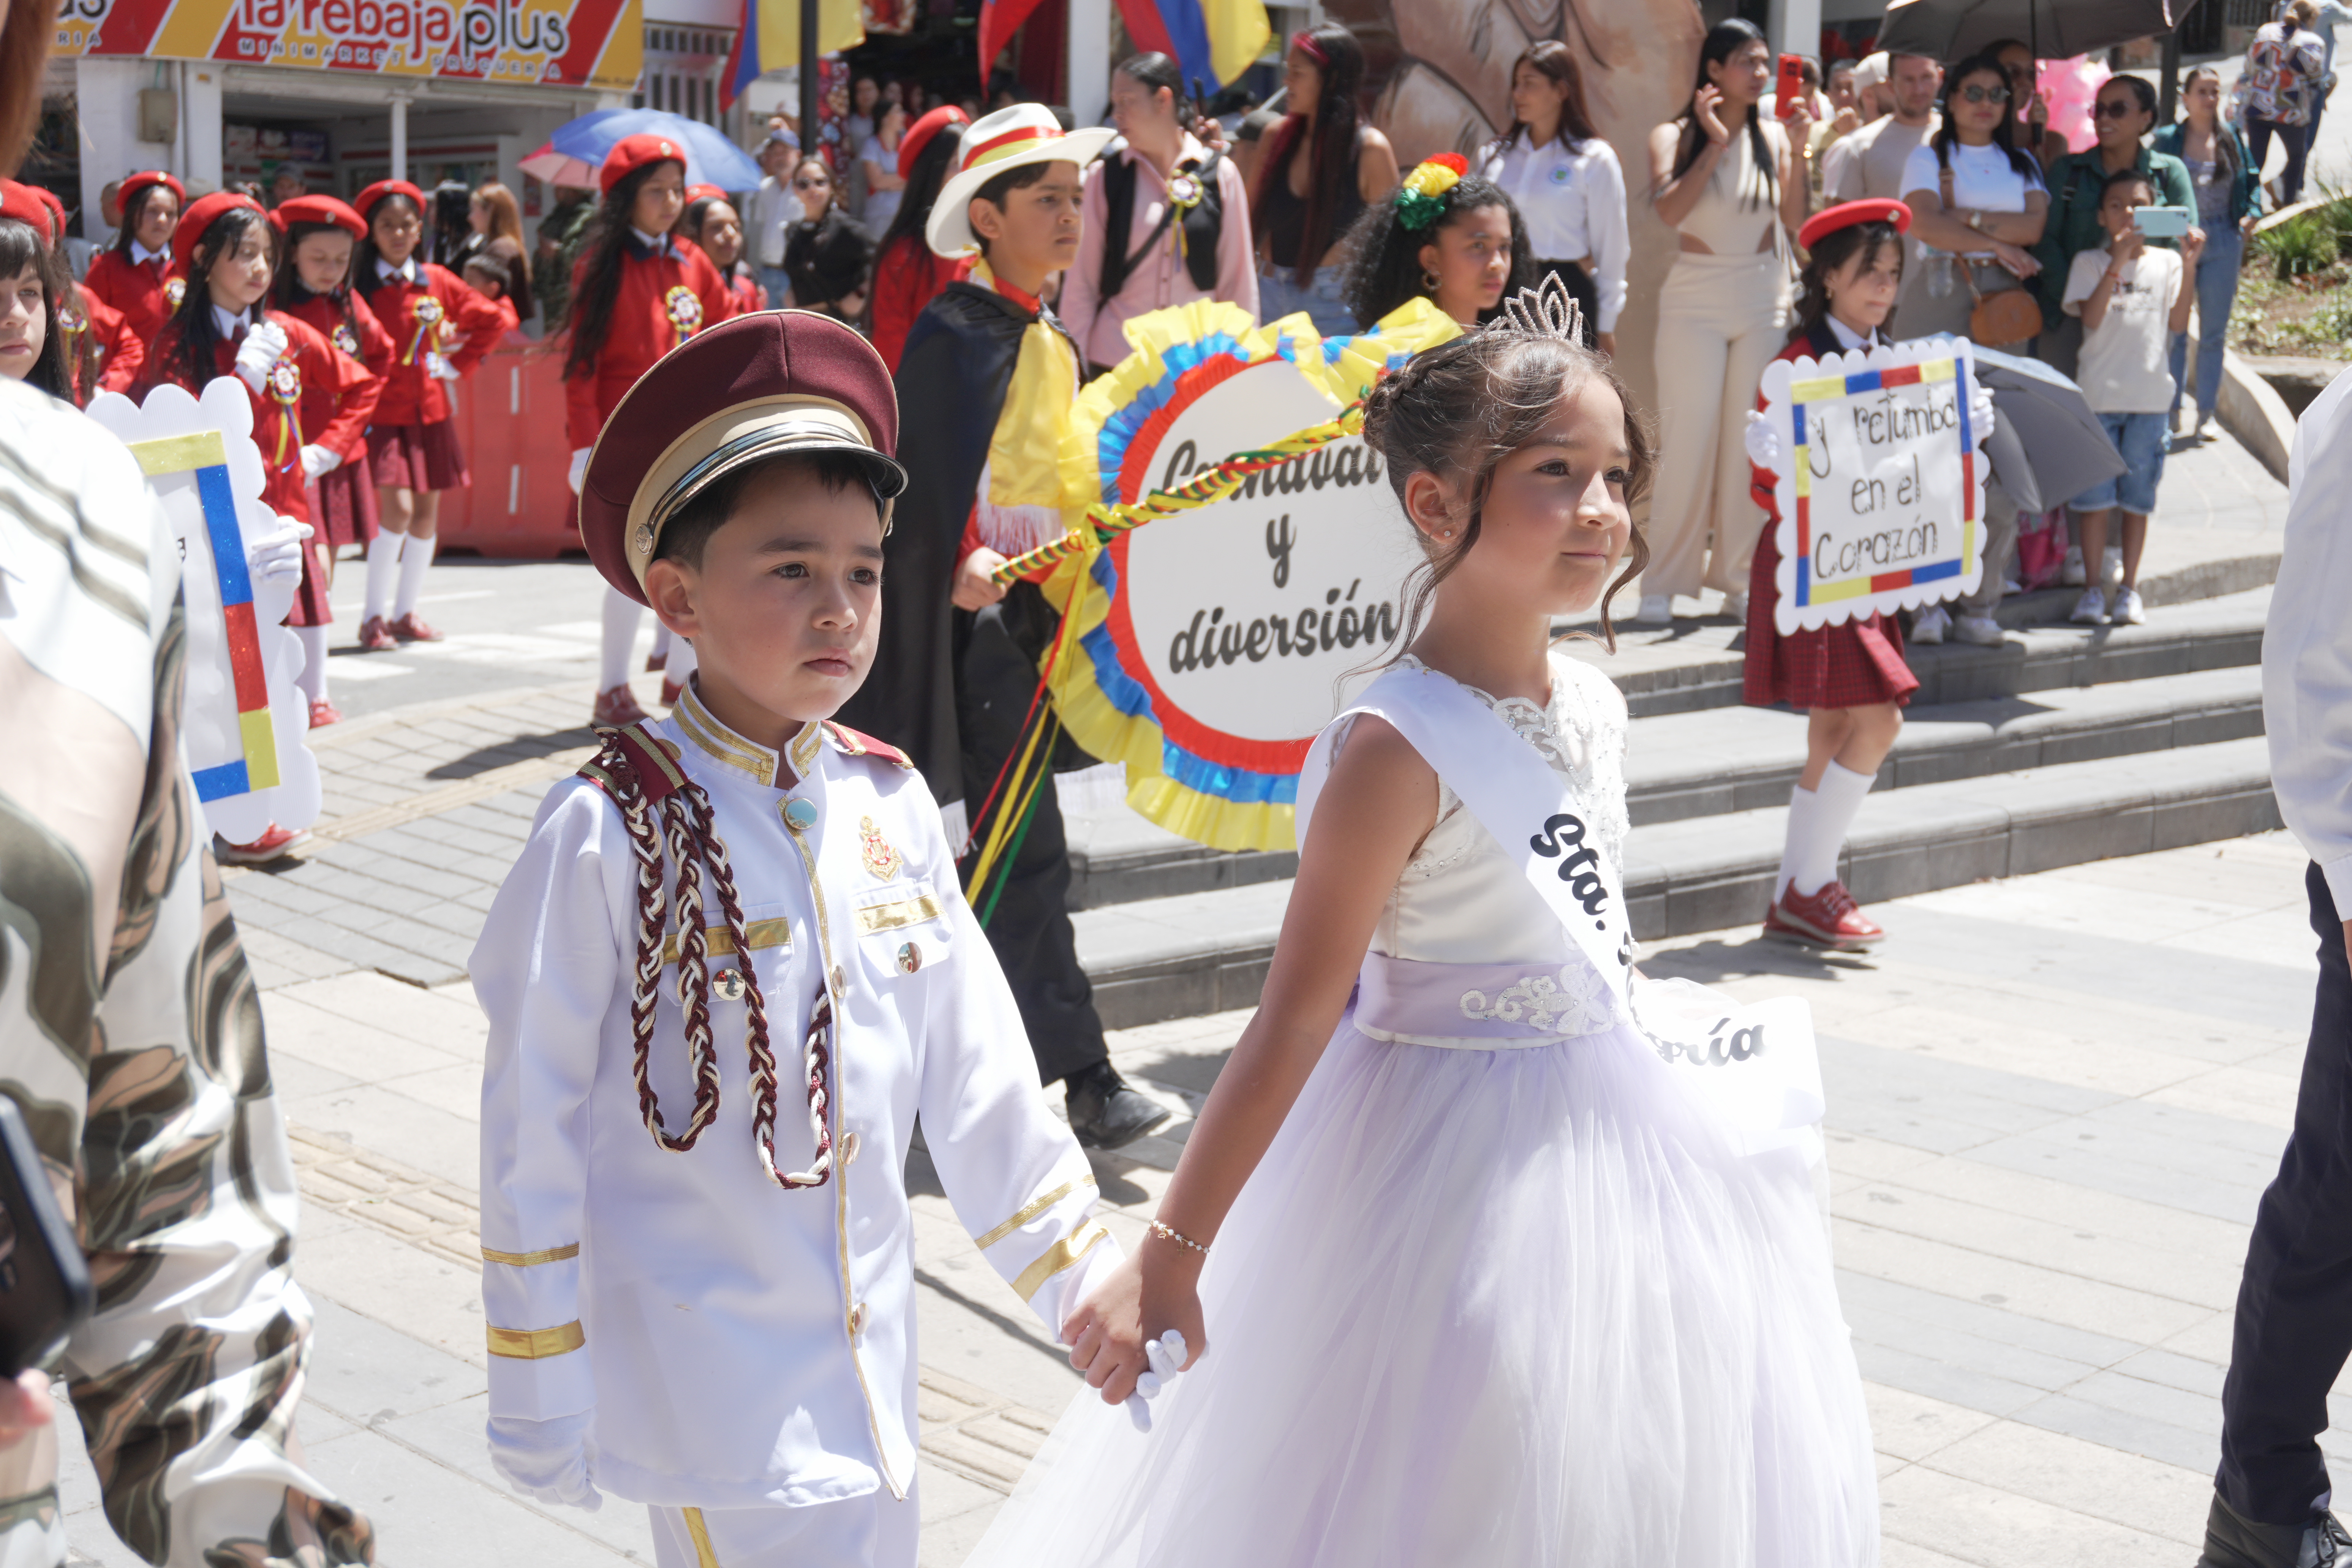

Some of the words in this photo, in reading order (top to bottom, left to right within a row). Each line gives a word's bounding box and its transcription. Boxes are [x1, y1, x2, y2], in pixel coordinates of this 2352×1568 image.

[240, 39, 401, 65] MINIMARKET
[303, 0, 451, 60] rebaja
[464, 0, 564, 57] plus
[1853, 384, 1958, 445] retumba
[1851, 478, 1886, 515] en
[1897, 452, 1921, 506] el
[1266, 513, 1297, 588] y
[1815, 514, 1938, 579] Corazón
[1170, 577, 1399, 674] diversión
[1530, 813, 1609, 931] Sta.
